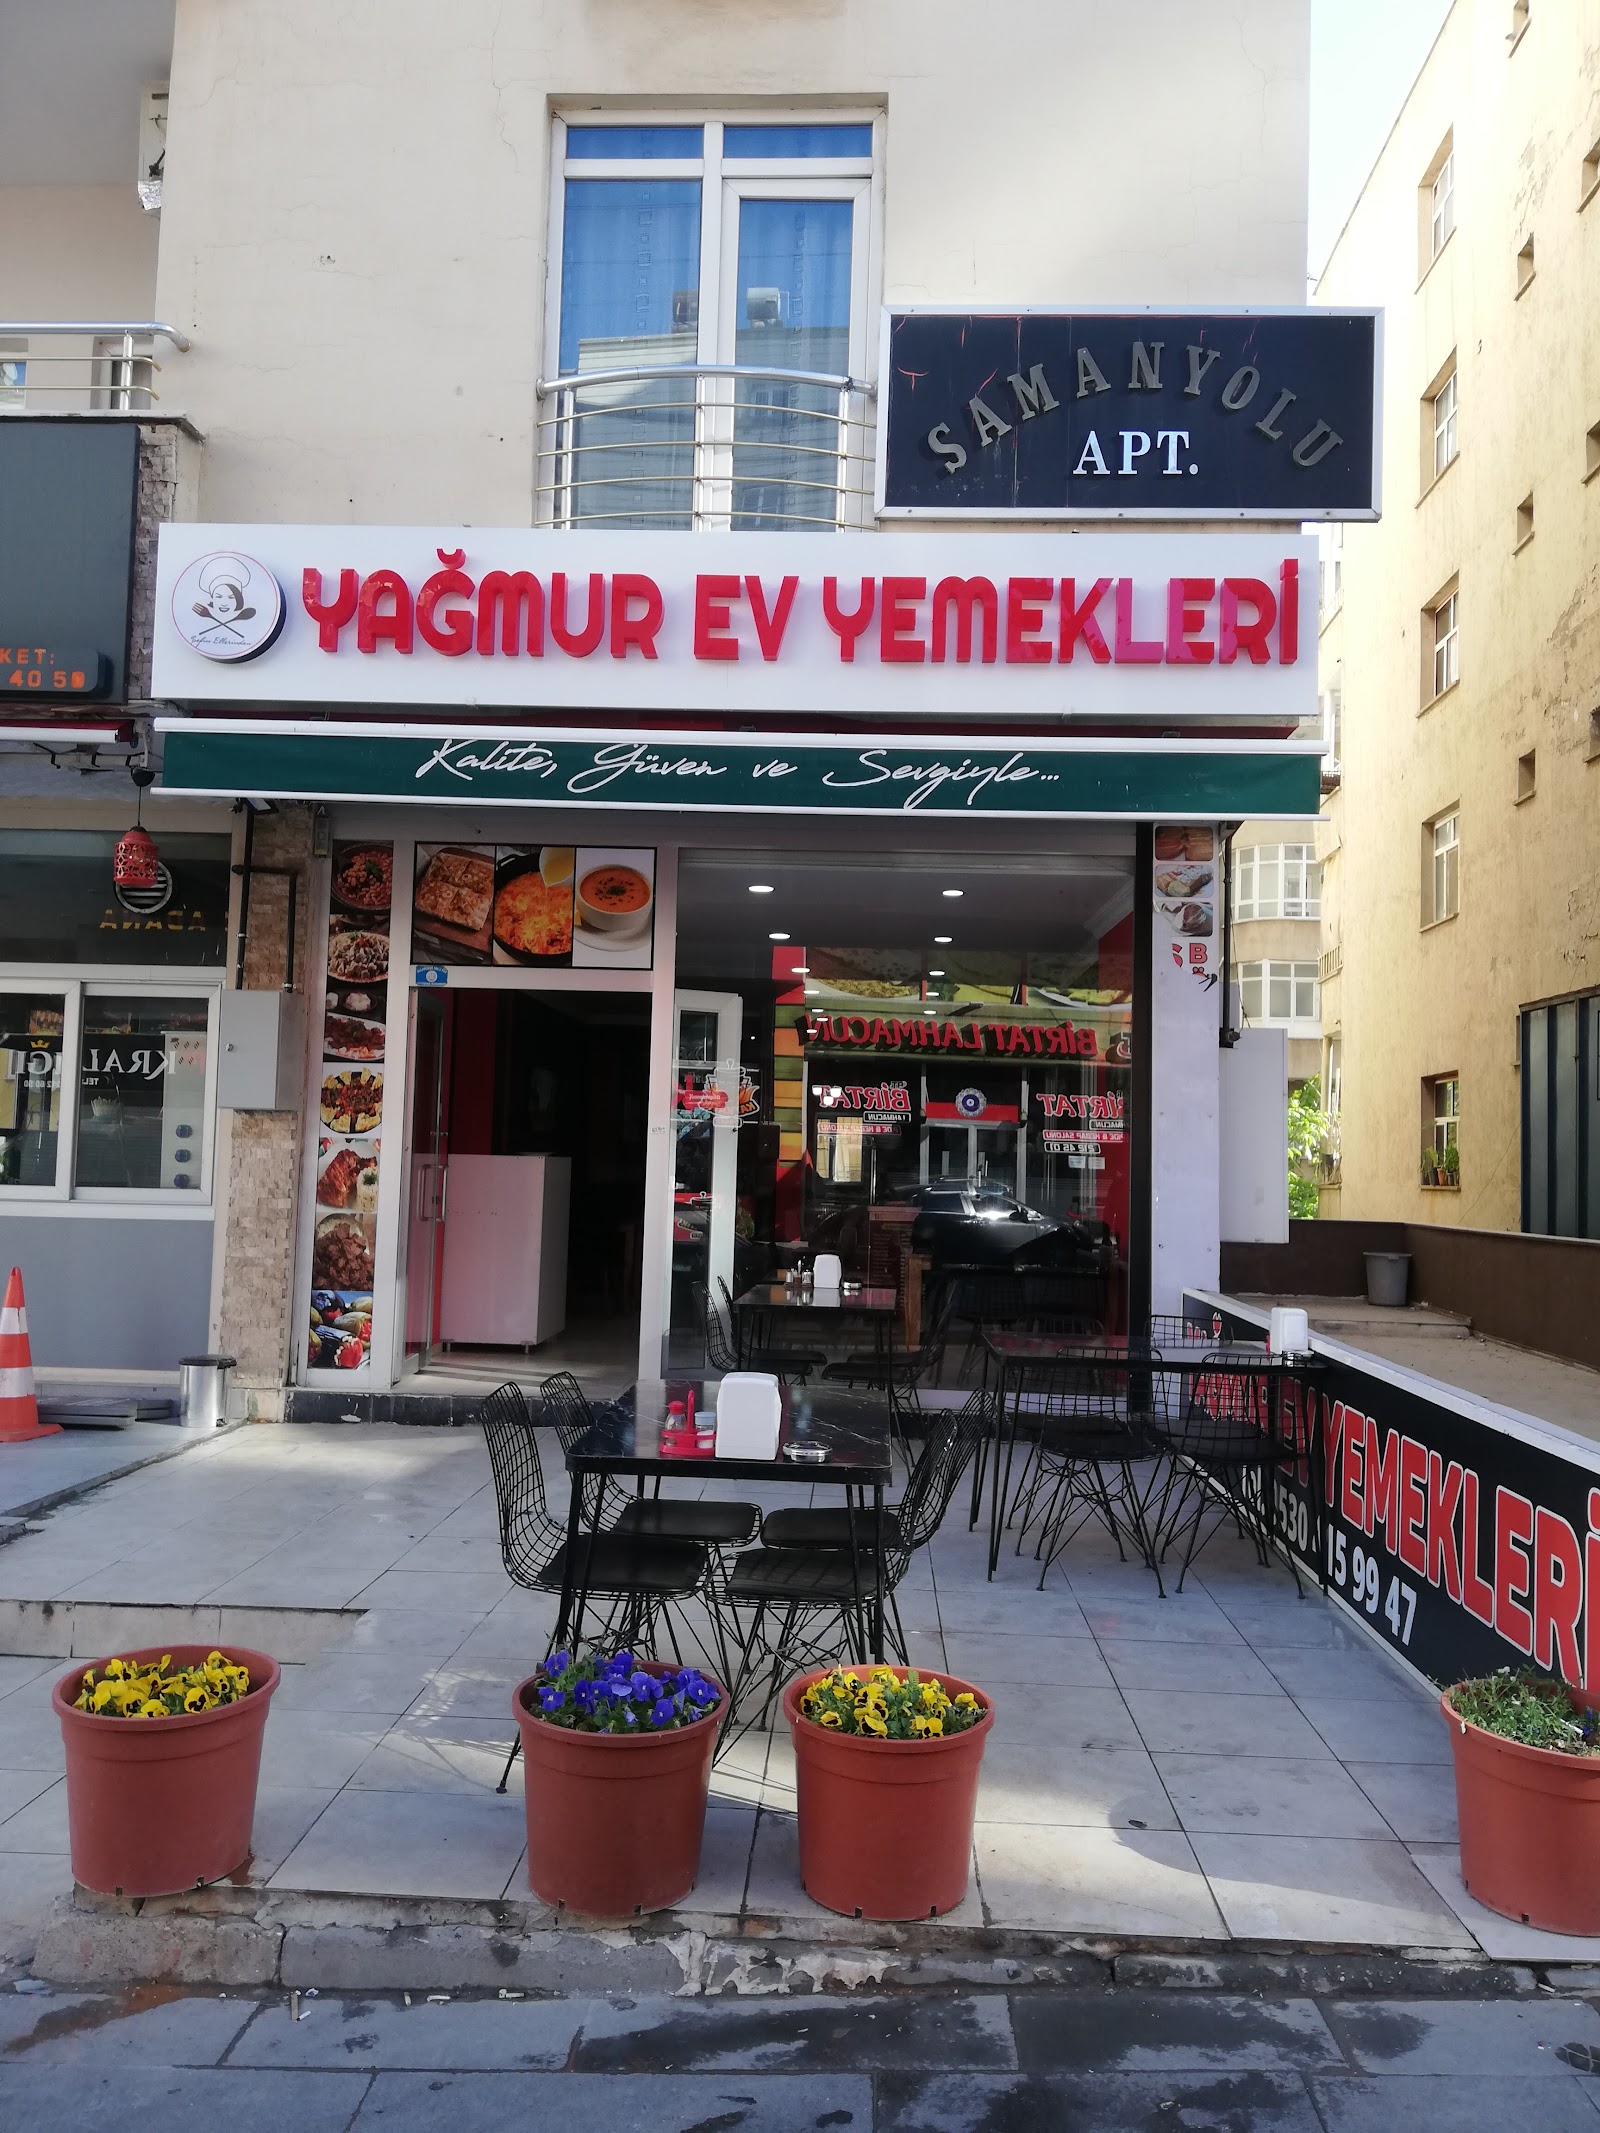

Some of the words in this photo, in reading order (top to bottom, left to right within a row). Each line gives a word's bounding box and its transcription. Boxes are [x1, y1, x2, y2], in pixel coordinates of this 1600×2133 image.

[927, 341, 1344, 474] SAMANYOLU
[1072, 430, 1200, 475] APT.
[302, 548, 665, 659] YAĞMUR
[693, 574, 800, 661] EV
[822, 558, 1299, 664] YEMEKLERİ
[415, 739, 558, 781] Kalite,
[566, 743, 728, 793] Güven
[752, 758, 798, 778] ve
[1353, 1546, 1379, 1614] 99
[1385, 1576, 1417, 1646] 47
